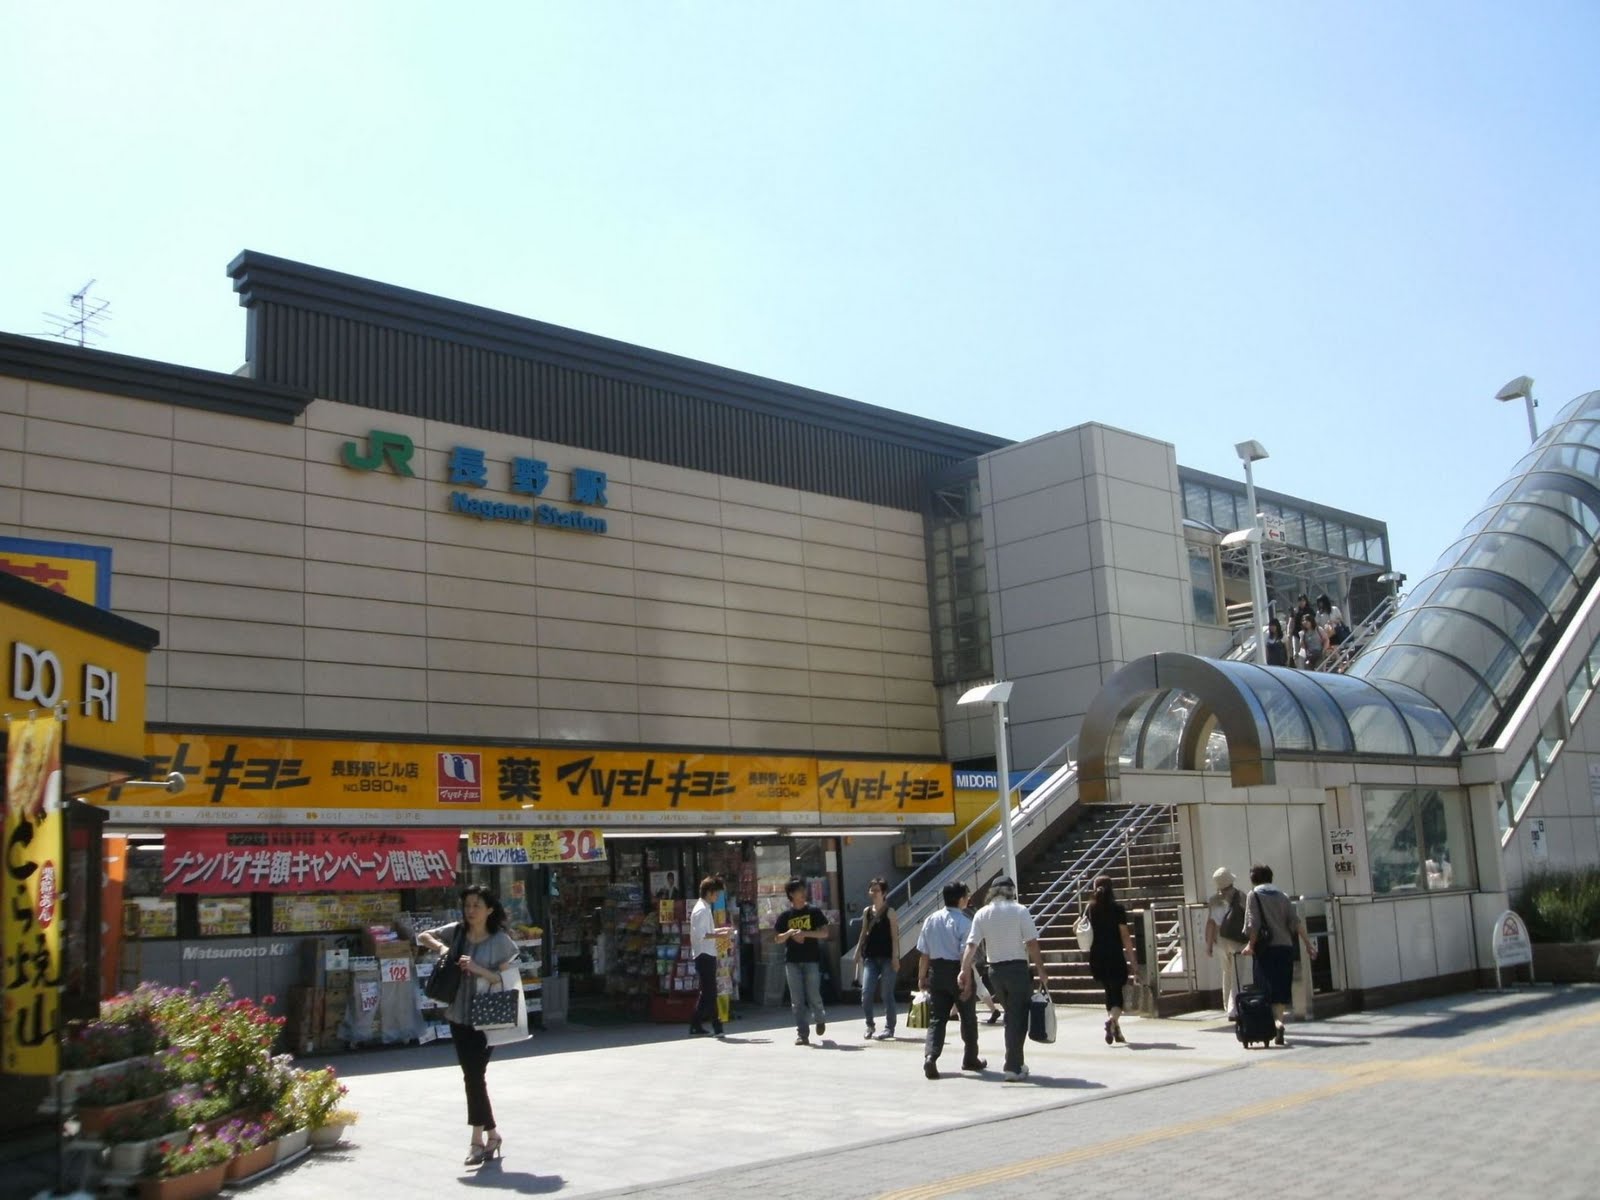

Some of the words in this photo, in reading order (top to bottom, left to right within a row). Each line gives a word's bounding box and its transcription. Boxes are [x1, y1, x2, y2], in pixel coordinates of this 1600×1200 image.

[343, 430, 414, 478] JR
[450, 446, 608, 508] 長野駅
[450, 491, 532, 523] Nagano
[535, 504, 607, 534] Station
[331, 760, 419, 778] 長野駅ビル店
[498, 757, 541, 802] 薬
[557, 756, 736, 808] マツモトキヨシ
[956, 773, 998, 789] MIDORI
[819, 768, 944, 808] マツモトキヨシ
[557, 829, 597, 861] 30
[183, 946, 265, 960] Matsumoto
[389, 966, 407, 981] 128
